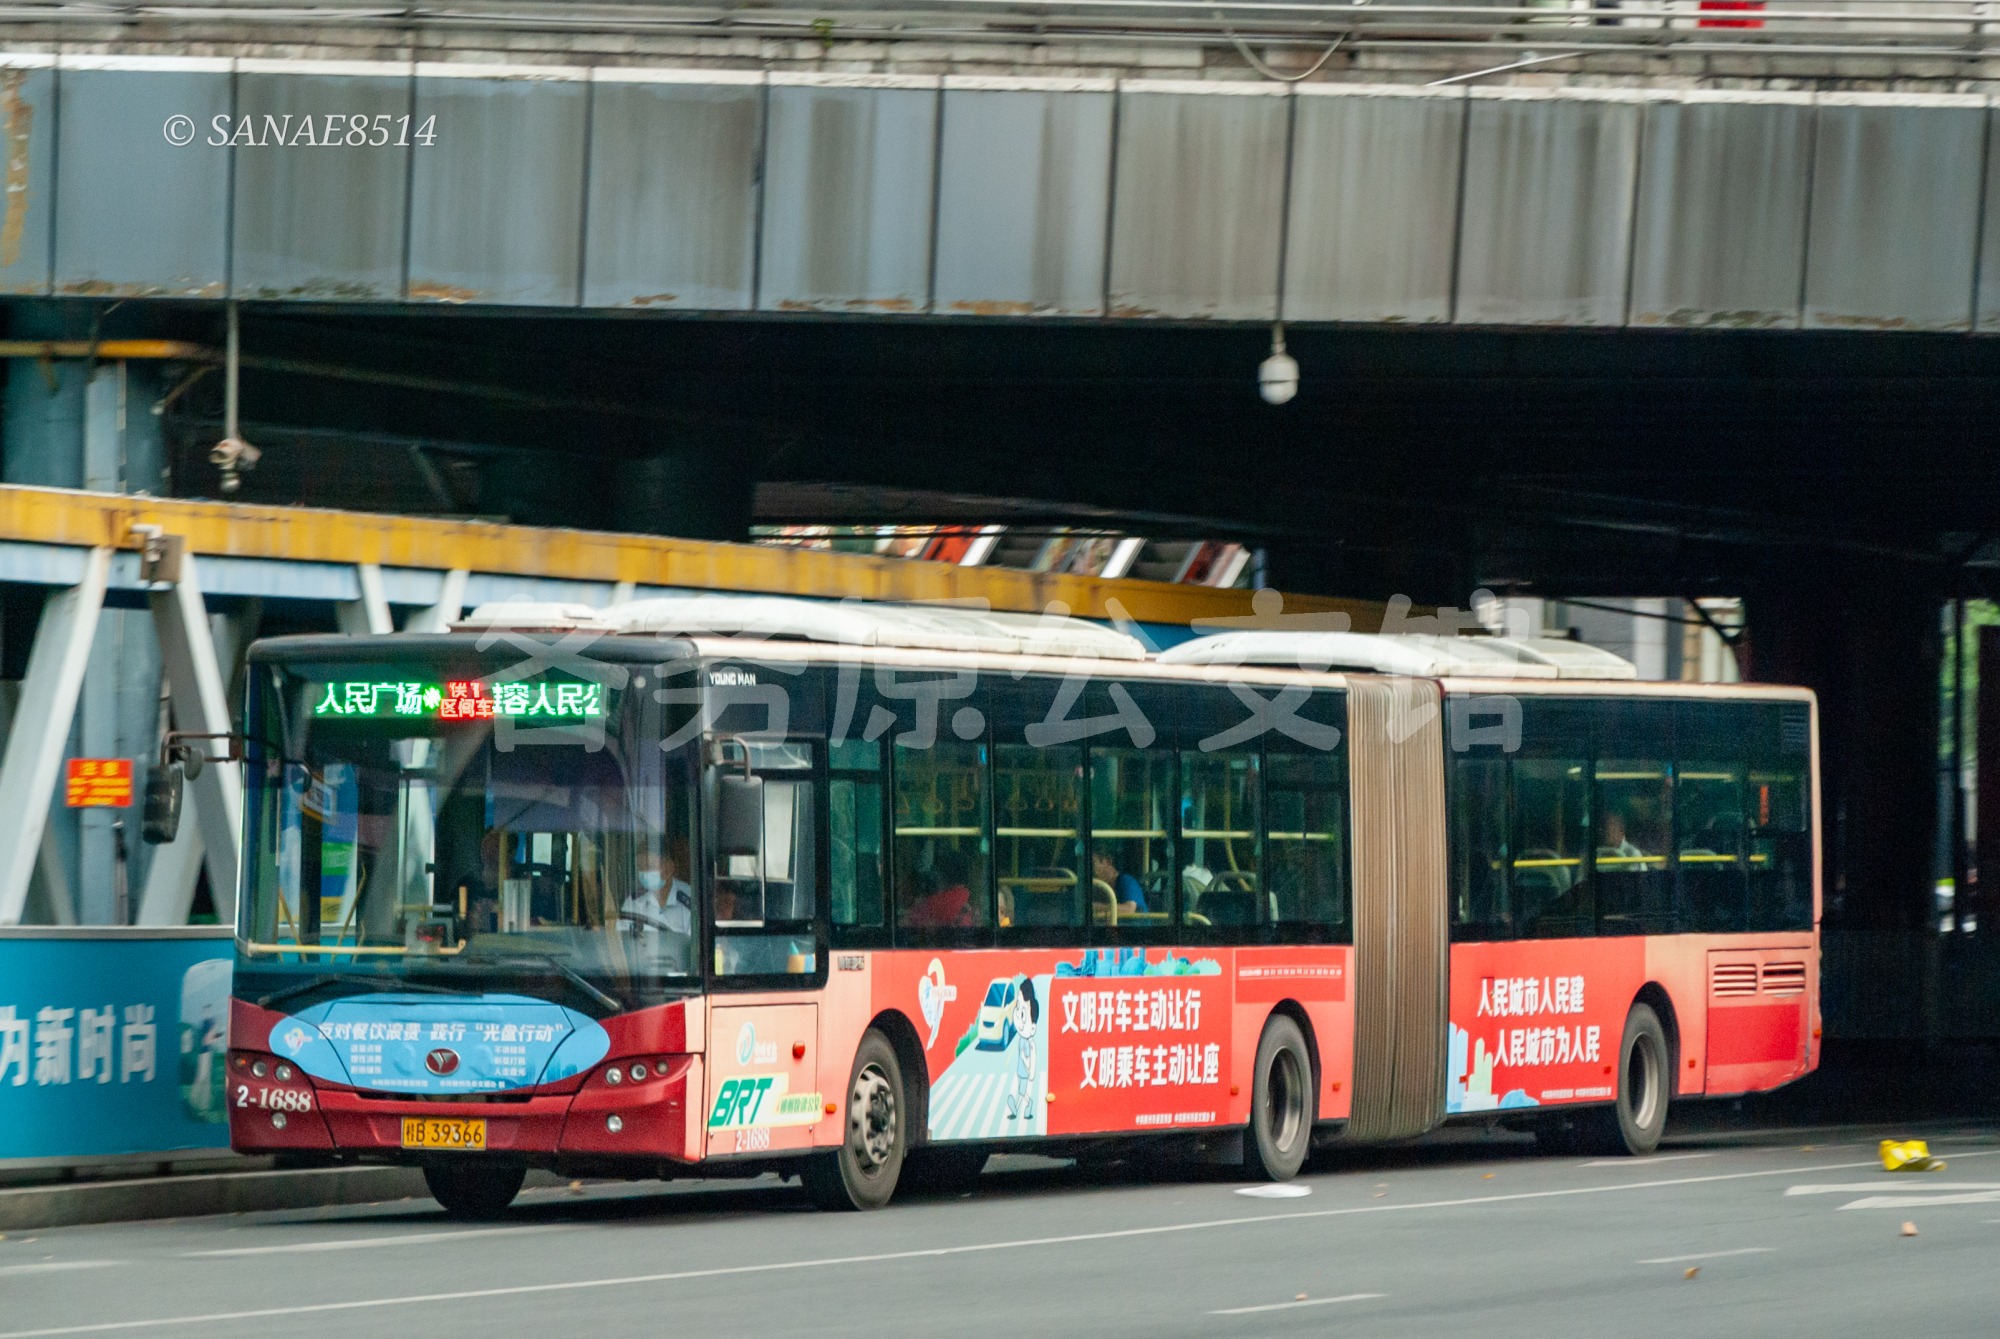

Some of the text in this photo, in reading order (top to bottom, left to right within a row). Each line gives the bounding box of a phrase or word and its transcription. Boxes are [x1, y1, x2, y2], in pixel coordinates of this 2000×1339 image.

[709, 672, 756, 686] YOUNG MAN
[316, 682, 422, 715] 人民广场
[440, 698, 494, 718] 区间车
[1061, 989, 1201, 1034] 文明开车主动让行
[1477, 975, 1584, 1017] 人民城市人民建
[318, 1022, 420, 1042] 反对餐饮浪费
[1493, 1025, 1600, 1068] 人民城市为人民
[1080, 1042, 1220, 1089] 文明乘车主动让座
[236, 1085, 312, 1113] 2-1688
[708, 1077, 774, 1127] BRT
[735, 1127, 770, 1152] 2-1688
